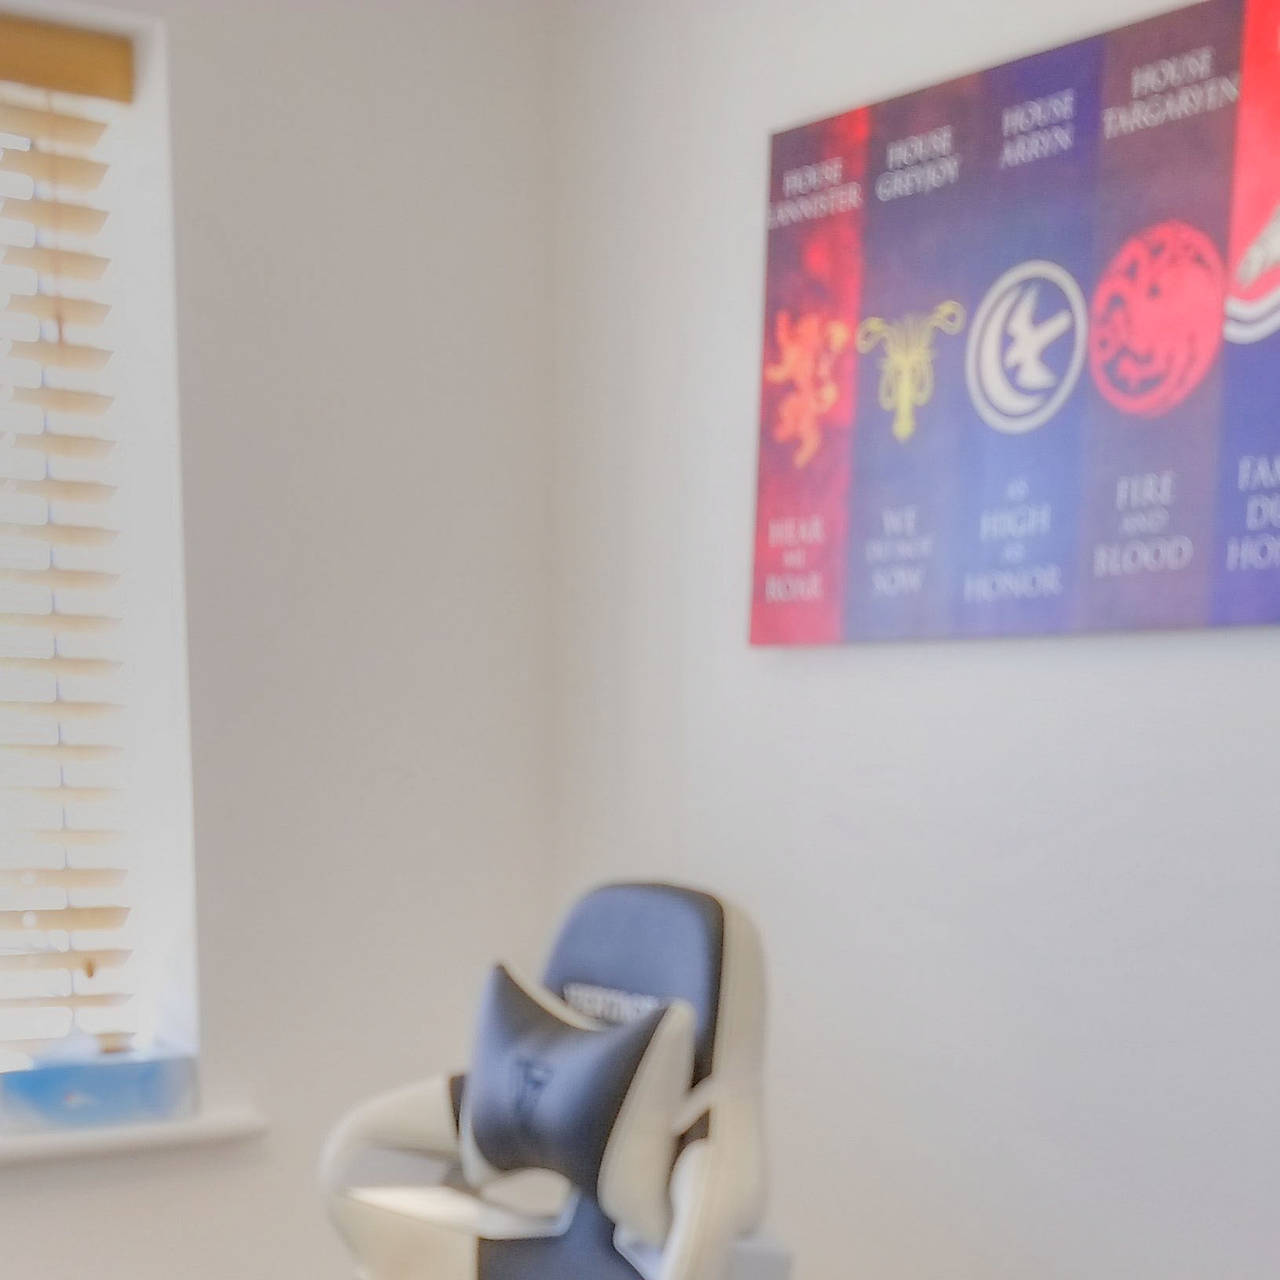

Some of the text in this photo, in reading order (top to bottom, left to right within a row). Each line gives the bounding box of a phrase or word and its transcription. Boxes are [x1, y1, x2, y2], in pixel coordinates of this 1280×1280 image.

[1116, 471, 1175, 511] FIRE
[980, 503, 1051, 542] HIGH
[1093, 535, 1194, 579] BLOOD
[964, 564, 1063, 604] HONOR
